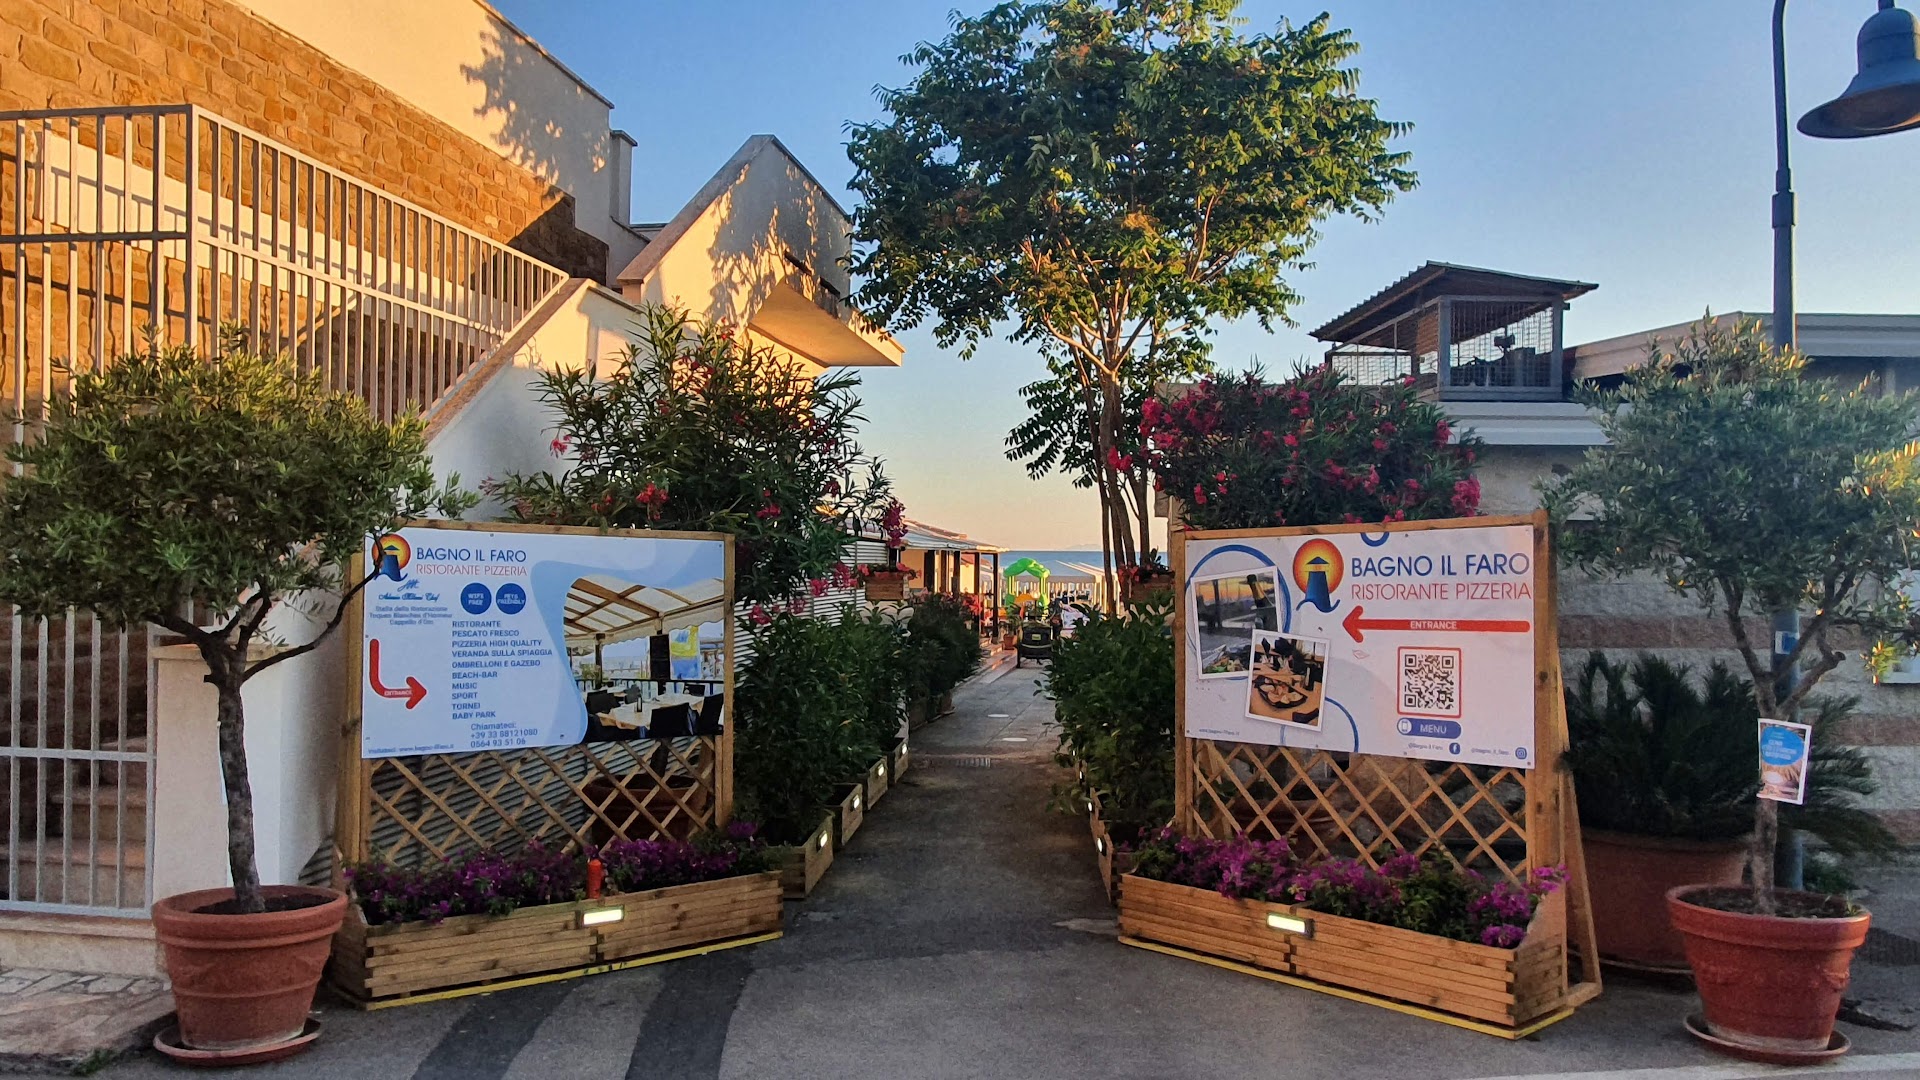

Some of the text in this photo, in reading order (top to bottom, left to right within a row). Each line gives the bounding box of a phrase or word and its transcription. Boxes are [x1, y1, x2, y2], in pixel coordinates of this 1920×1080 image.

[416, 547, 527, 562] BAGNO IL FARO
[1351, 552, 1530, 577] BAGNO IL FARO
[416, 563, 527, 576] RISTORANTE PIZZERIA
[1351, 582, 1532, 600] RISTORANTE PIZZERIA
[1410, 620, 1457, 630] ENTRANCE
[490, 629, 520, 637] FRESCO
[452, 640, 487, 648] PIZZERIA
[510, 639, 542, 647] QUALITY
[452, 650, 489, 658] VERANDA
[452, 661, 502, 669] OMBRELLONI
[510, 659, 541, 667] GAZEBO
[452, 671, 498, 679] BEACH-BAR
[452, 682, 477, 690] MUSIC
[452, 692, 478, 700] SPORT
[452, 702, 481, 710] TORNEI
[452, 712, 474, 720] BABY
[1420, 724, 1447, 734] MENU
[471, 731, 486, 739] +39
[487, 730, 498, 739] 33
[470, 740, 490, 749] 0564
[493, 739, 502, 747] 93
[504, 738, 514, 746] 51
